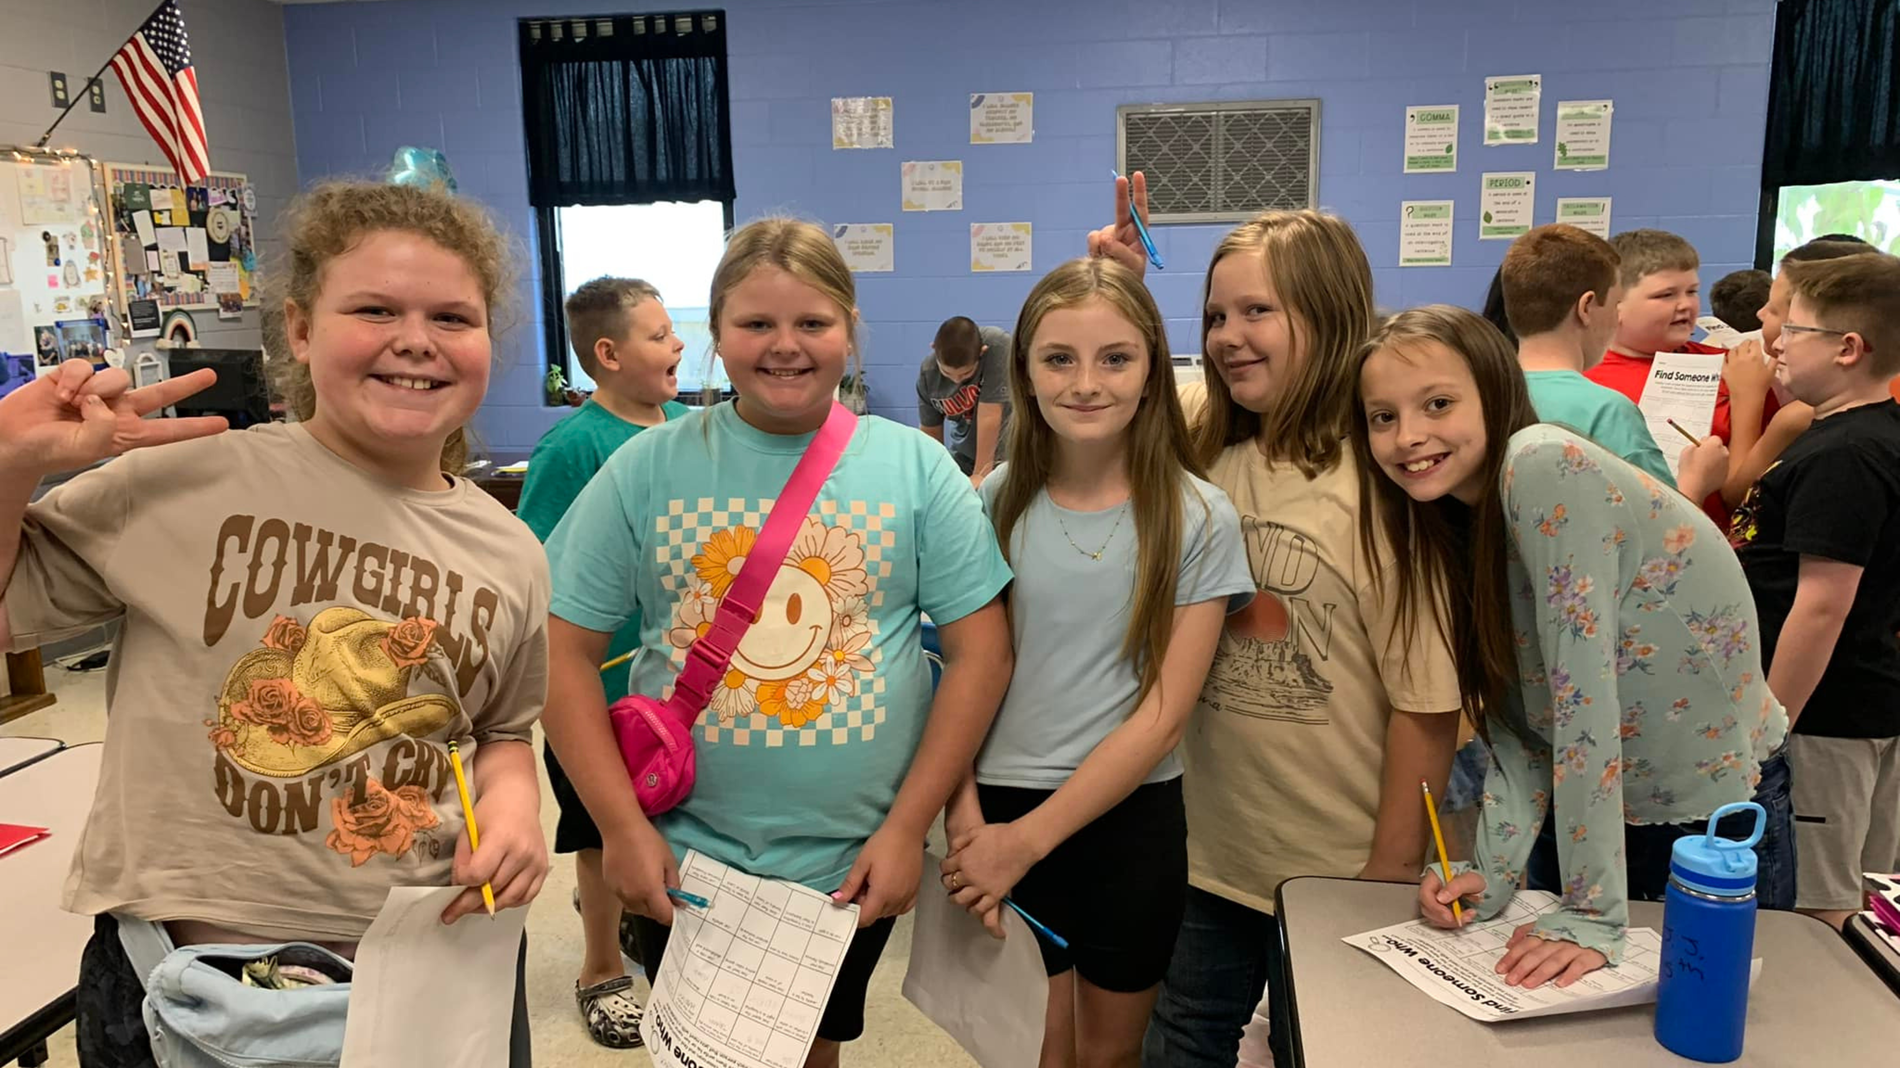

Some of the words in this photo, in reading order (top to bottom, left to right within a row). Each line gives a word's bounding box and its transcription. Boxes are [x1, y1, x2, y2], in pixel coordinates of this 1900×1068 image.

[1420, 113, 1451, 121] COMMA
[1490, 178, 1520, 187] PERIOD
[1654, 369, 1674, 380] Find
[1674, 371, 1710, 382] Someone
[203, 514, 498, 698] COWGIRLS
[214, 749, 370, 835] DON'T
[383, 739, 452, 804] CRY
[1418, 957, 1485, 1001] Someone
